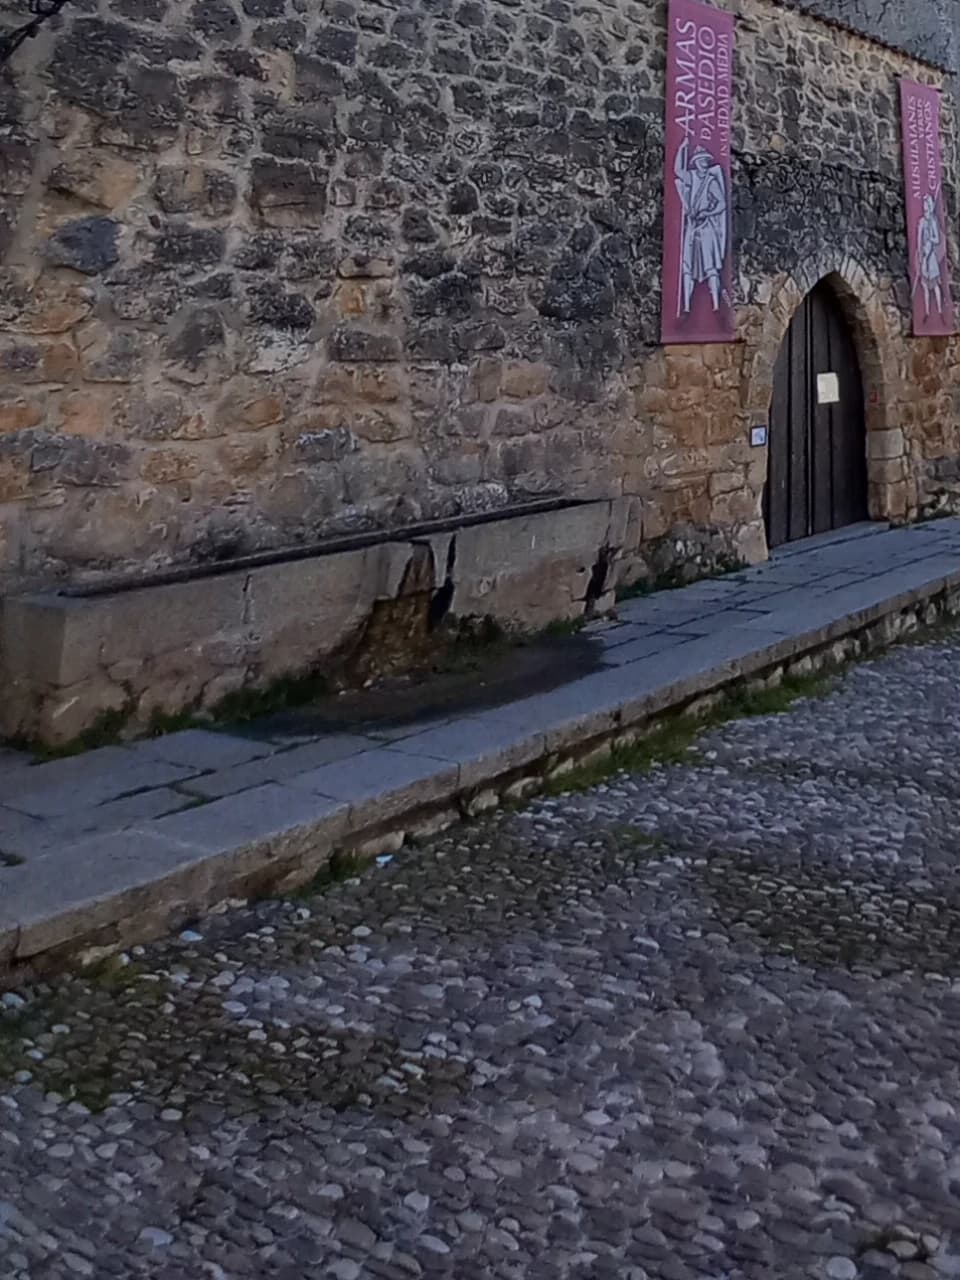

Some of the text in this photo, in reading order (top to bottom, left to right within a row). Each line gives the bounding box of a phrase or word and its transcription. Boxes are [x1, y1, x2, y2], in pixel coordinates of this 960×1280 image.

[675, 18, 697, 137] ARMAS
[698, 26, 716, 131] ASEDIO
[717, 34, 729, 81] MEDIA
[717, 85, 729, 127] EDAD
[924, 101, 937, 190] CRISTIANOS
